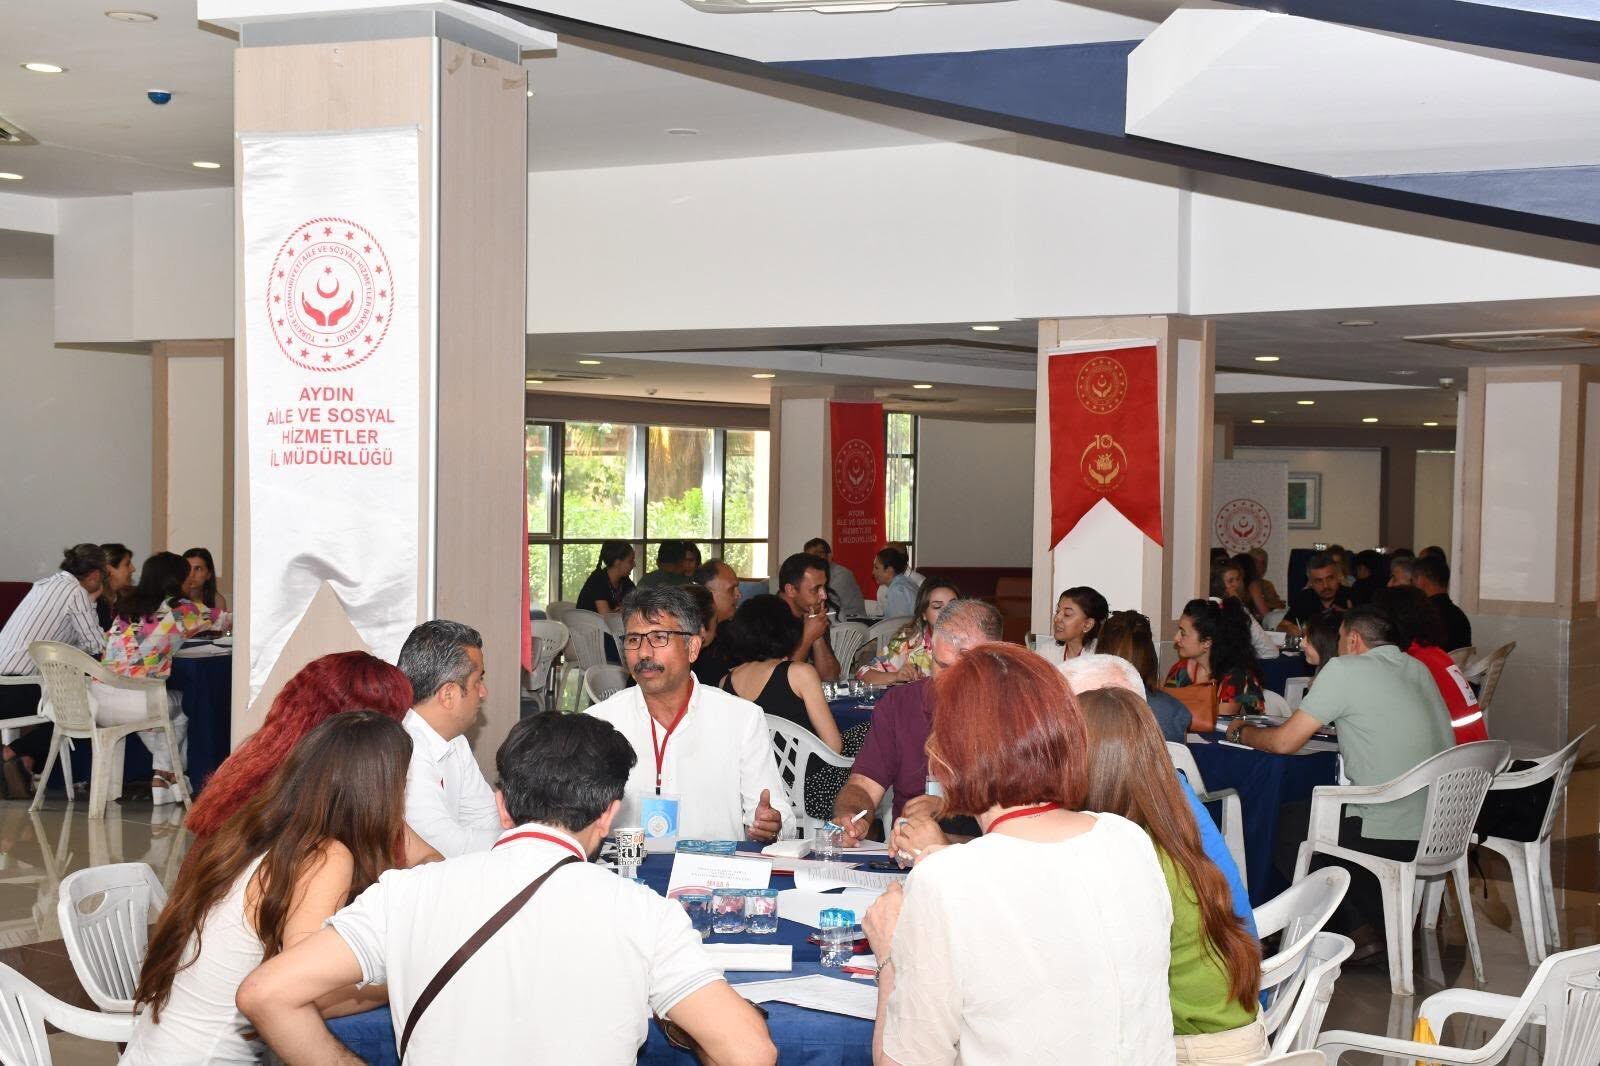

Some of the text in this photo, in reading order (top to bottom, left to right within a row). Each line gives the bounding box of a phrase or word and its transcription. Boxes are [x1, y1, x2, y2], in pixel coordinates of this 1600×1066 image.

[317, 245, 328, 253] VE
[329, 245, 356, 264] SOSYAL
[299, 387, 354, 402] AYDIN
[266, 407, 395, 426] AİLE VE SOSYAL
[282, 426, 378, 444] HİZMETLER
[270, 447, 393, 467] İL MÜDÜRLÜĞÜ
